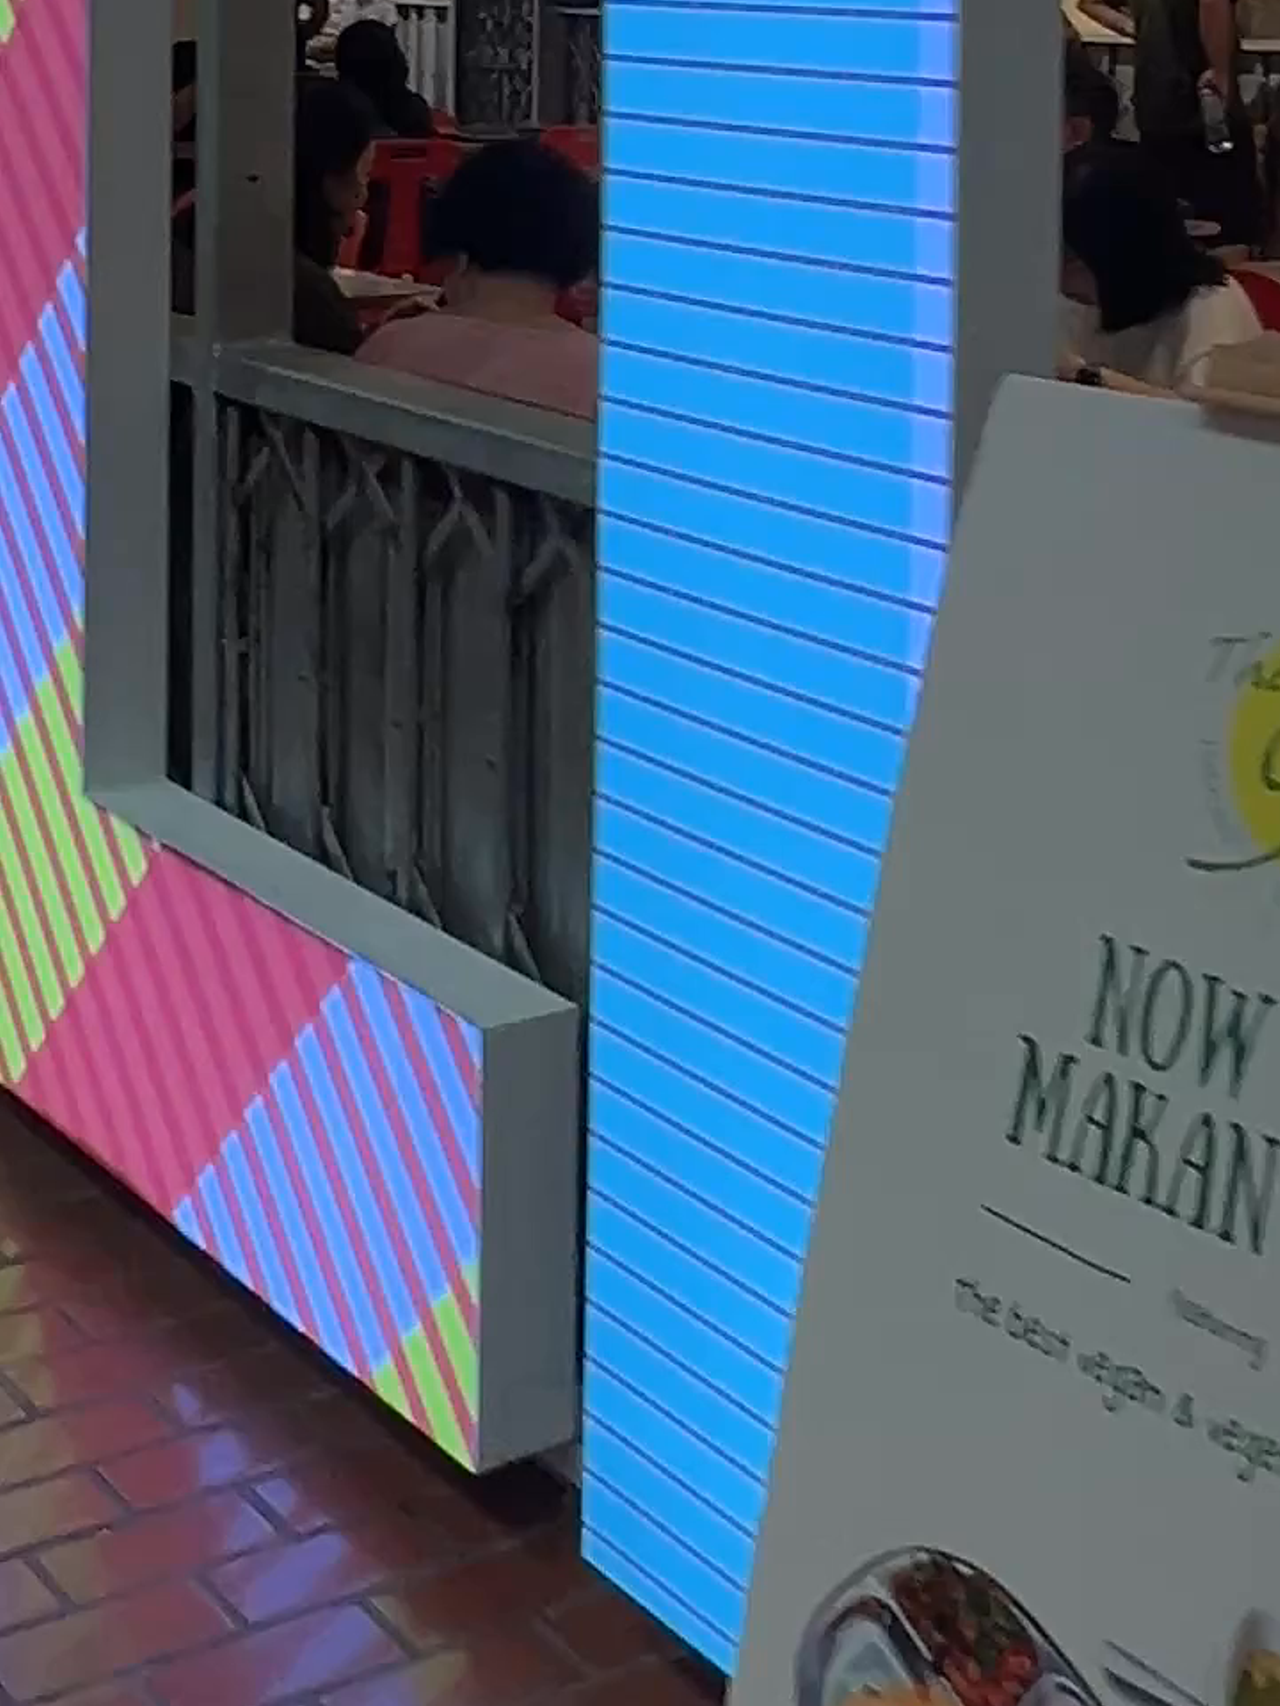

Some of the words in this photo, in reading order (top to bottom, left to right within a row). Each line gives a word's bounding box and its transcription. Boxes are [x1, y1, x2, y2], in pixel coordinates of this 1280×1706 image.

[1083, 932, 1280, 1100] NOW
[954, 1278, 1002, 1328] The
[1005, 1299, 1070, 1362] best
[1076, 1350, 1167, 1413] vegan
